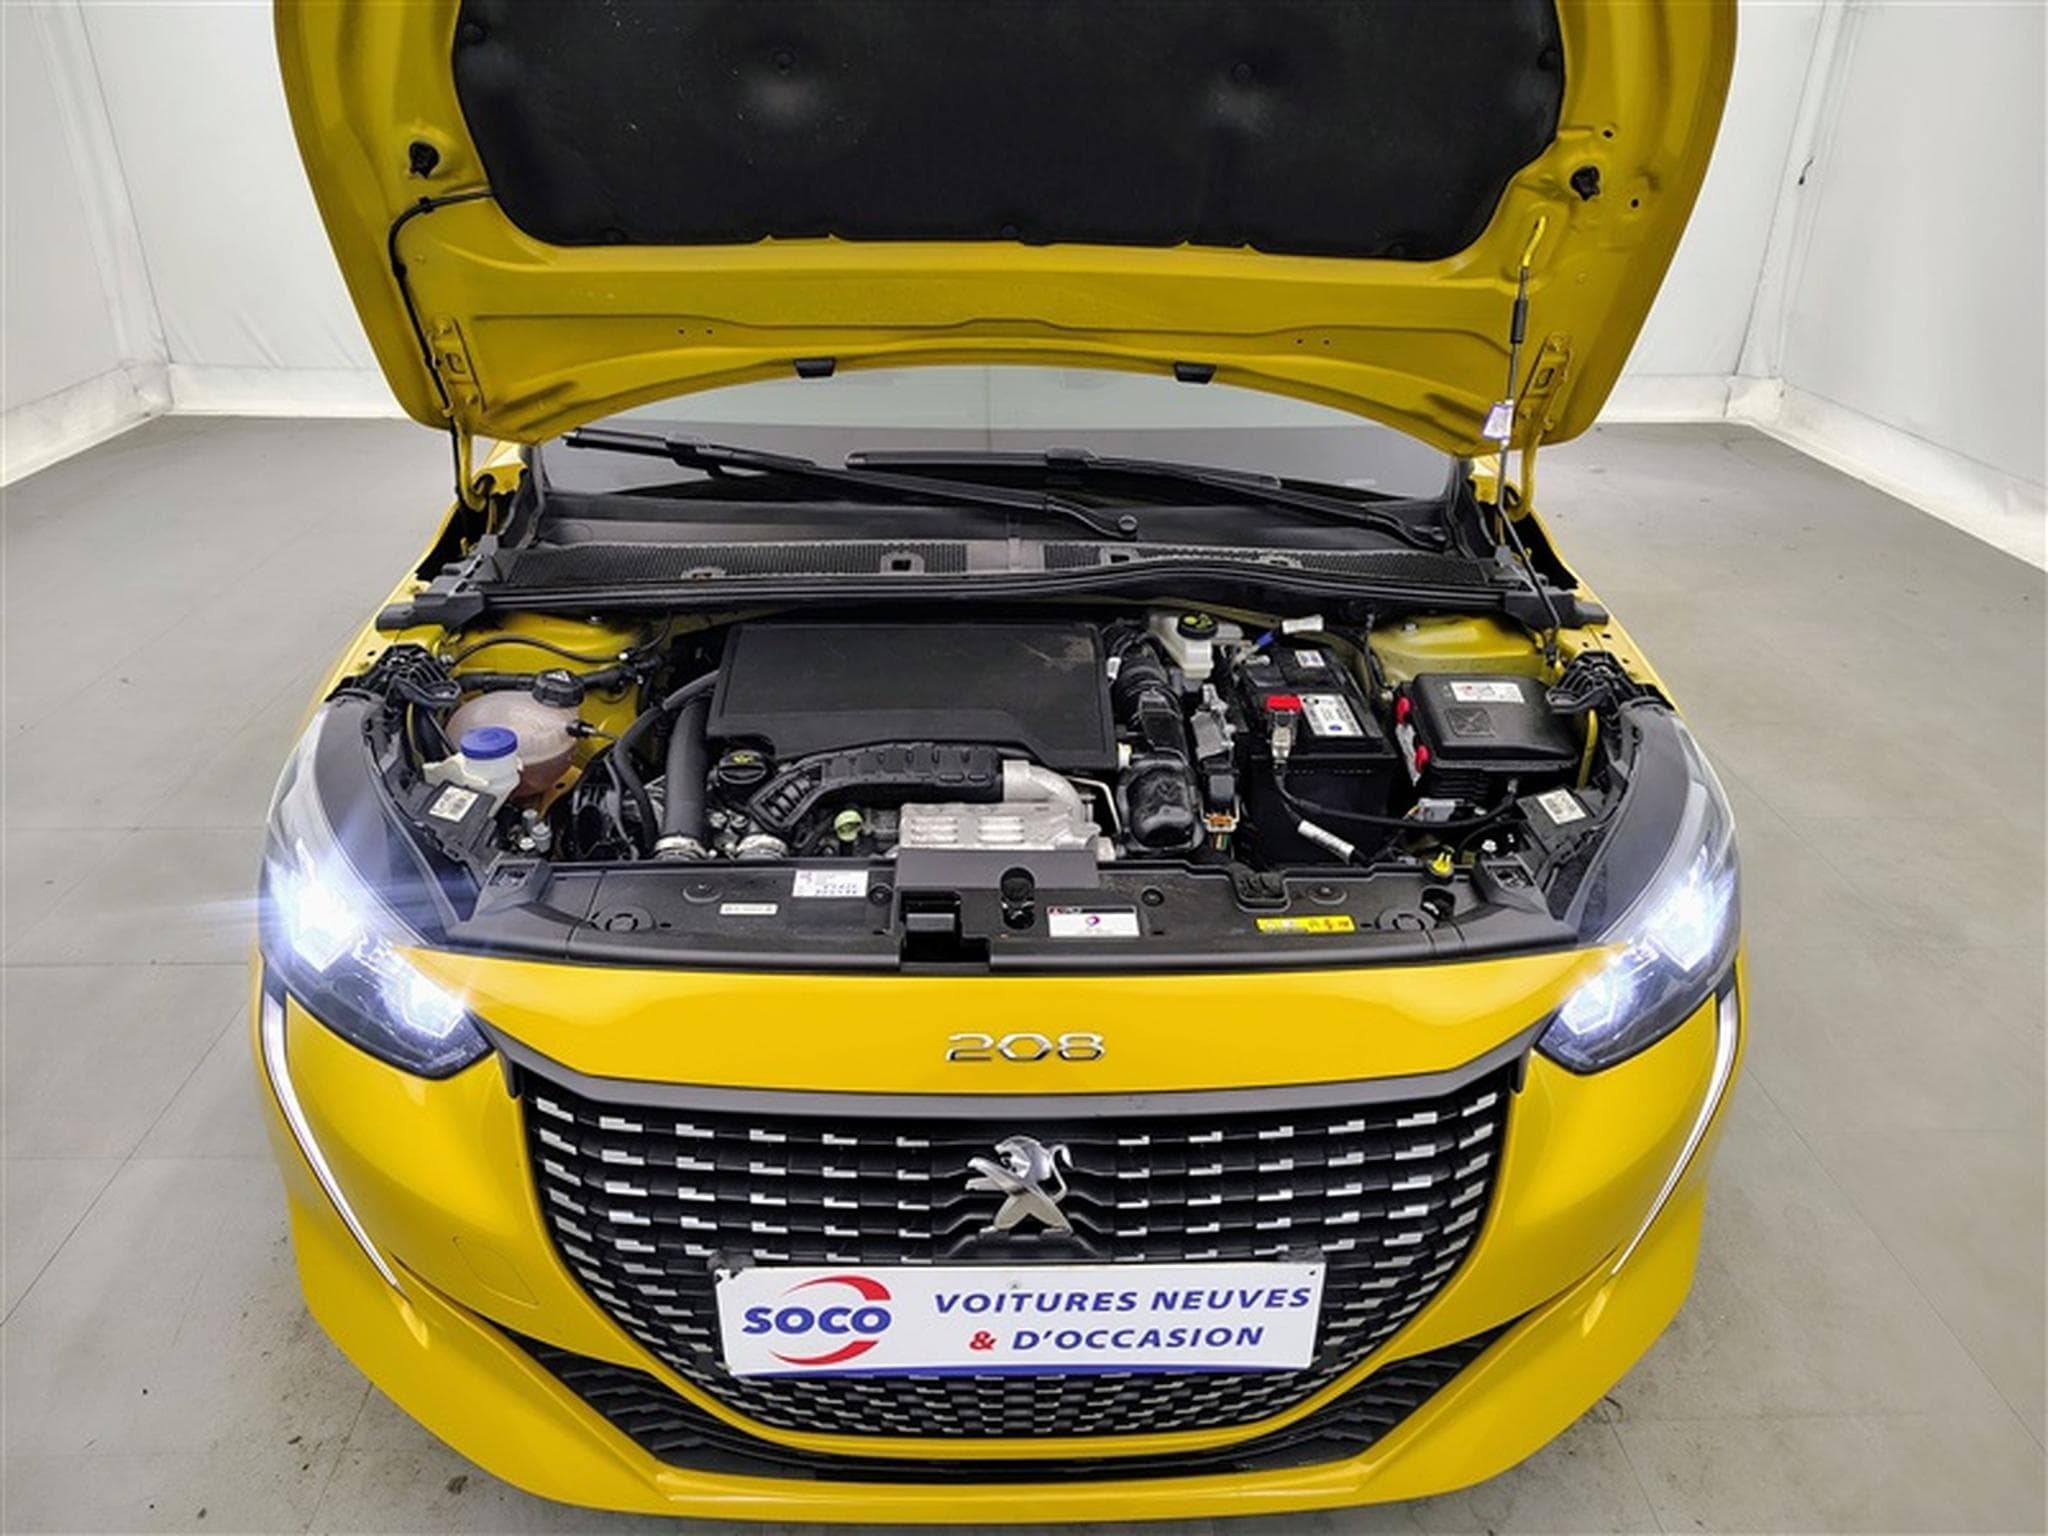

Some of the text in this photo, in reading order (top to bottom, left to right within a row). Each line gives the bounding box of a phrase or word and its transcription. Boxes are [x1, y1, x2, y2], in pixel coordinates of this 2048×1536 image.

[945, 1033, 1105, 1061] 208
[935, 1286, 1311, 1314] VOITURES NEUVES
[742, 1305, 893, 1335] SOCO
[969, 1326, 1264, 1351] & D'OCCASION
